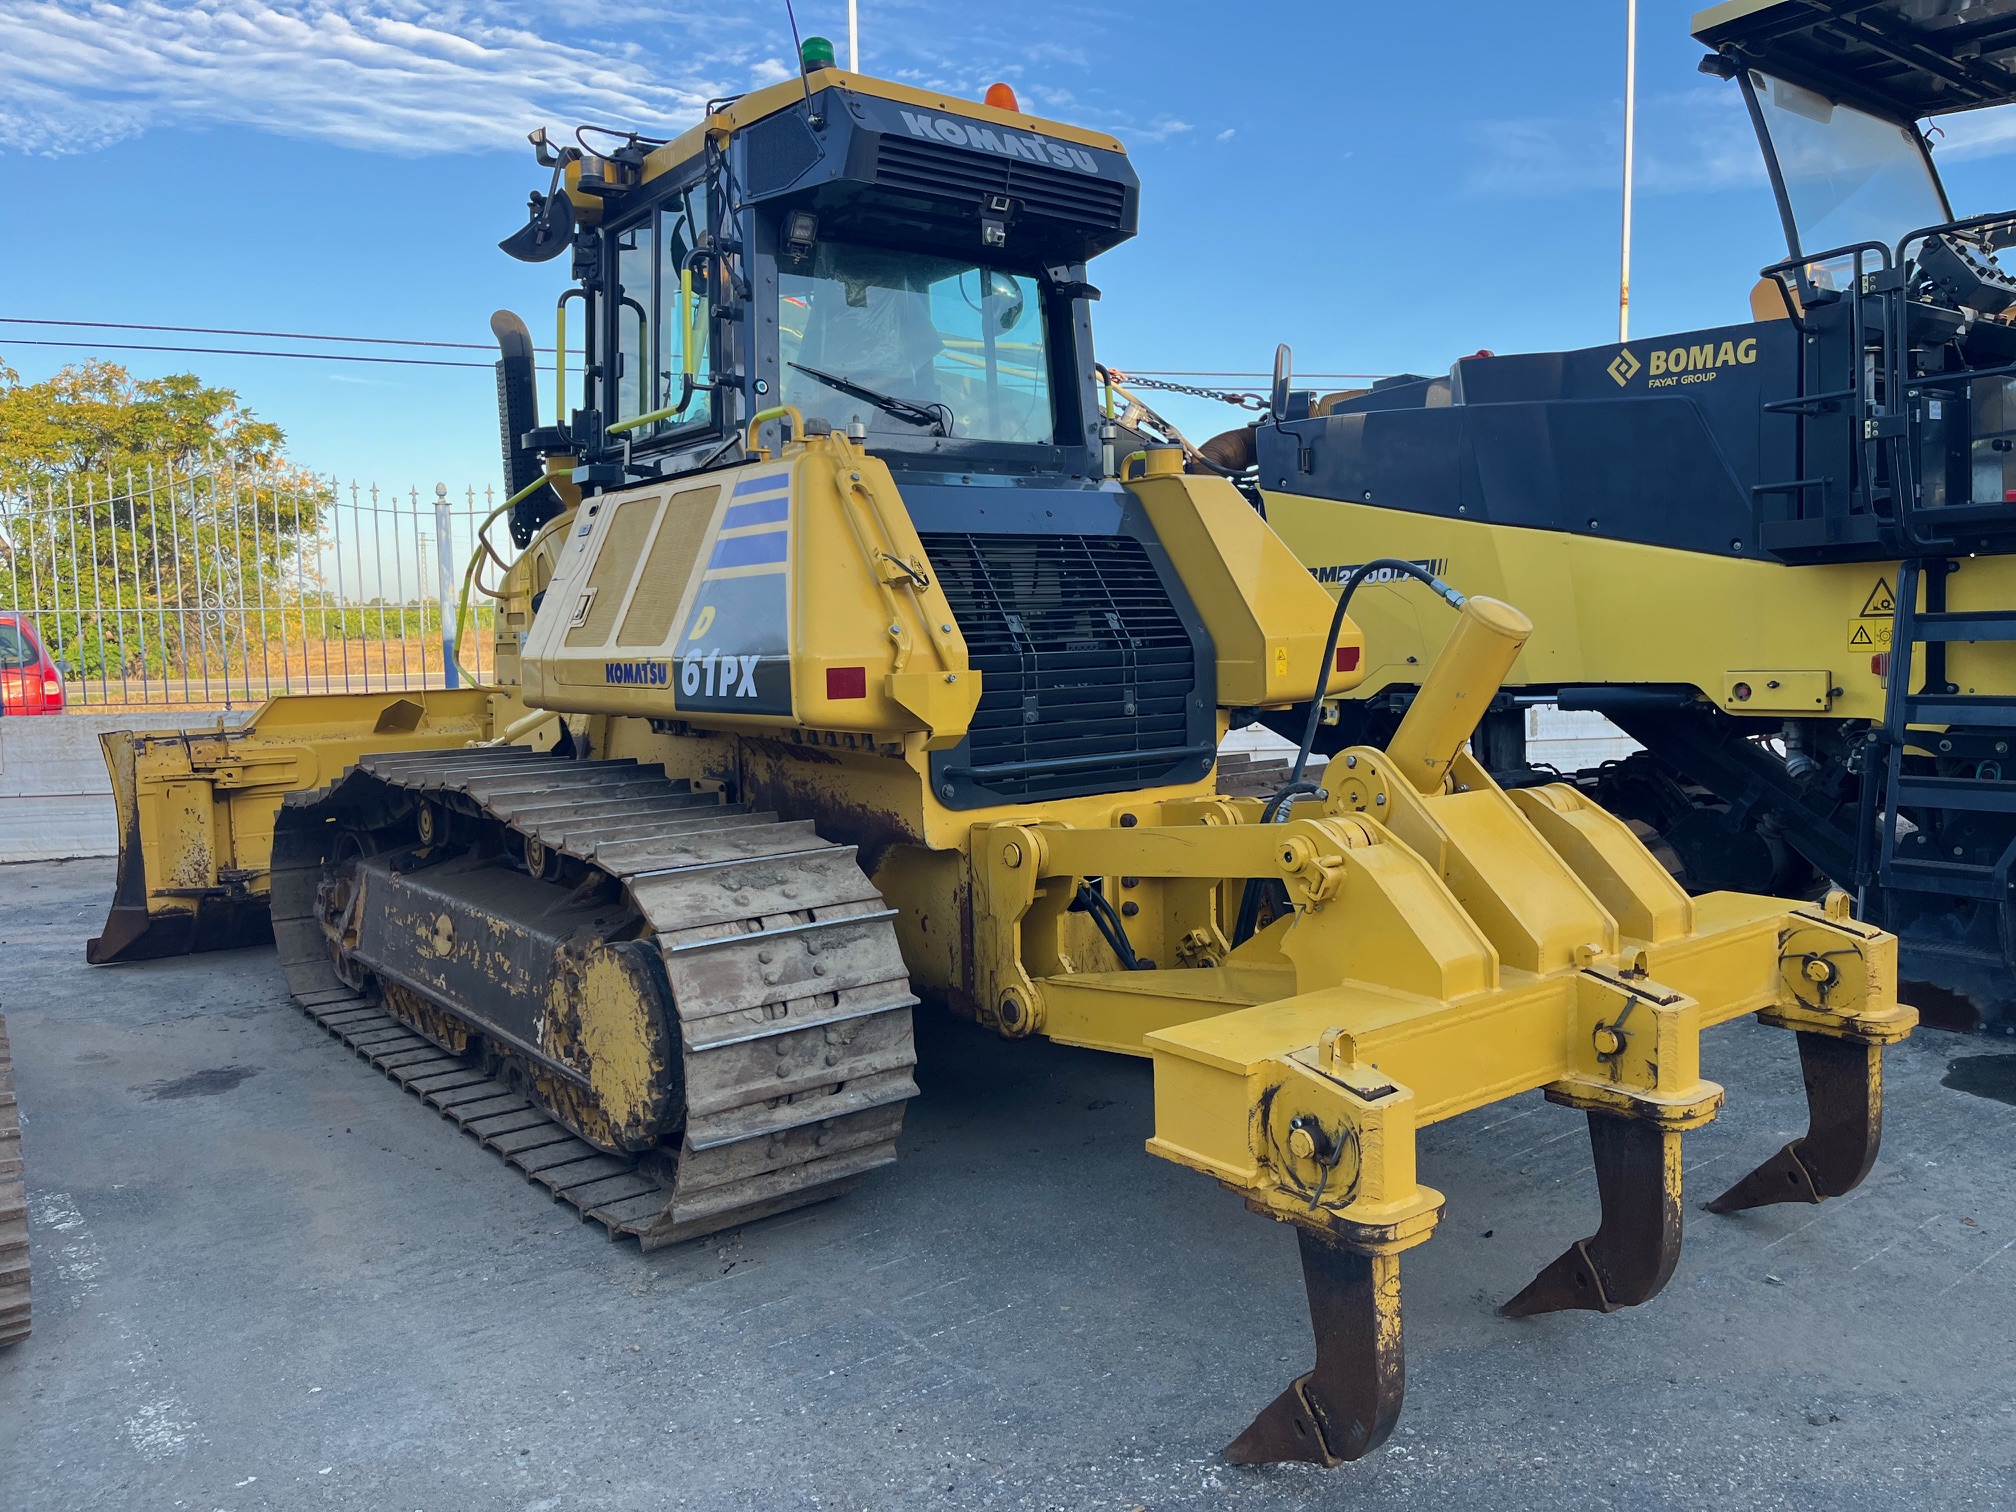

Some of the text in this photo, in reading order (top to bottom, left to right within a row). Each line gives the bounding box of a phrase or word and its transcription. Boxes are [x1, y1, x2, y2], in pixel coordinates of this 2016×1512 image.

[900, 110, 1099, 174] KOMATSU
[1649, 337, 1757, 376] BOMAG
[1648, 372, 1716, 388] FAYAT GROUP
[688, 605, 716, 641] D
[605, 658, 667, 685] KOMATSU
[681, 648, 761, 698] 61PX
